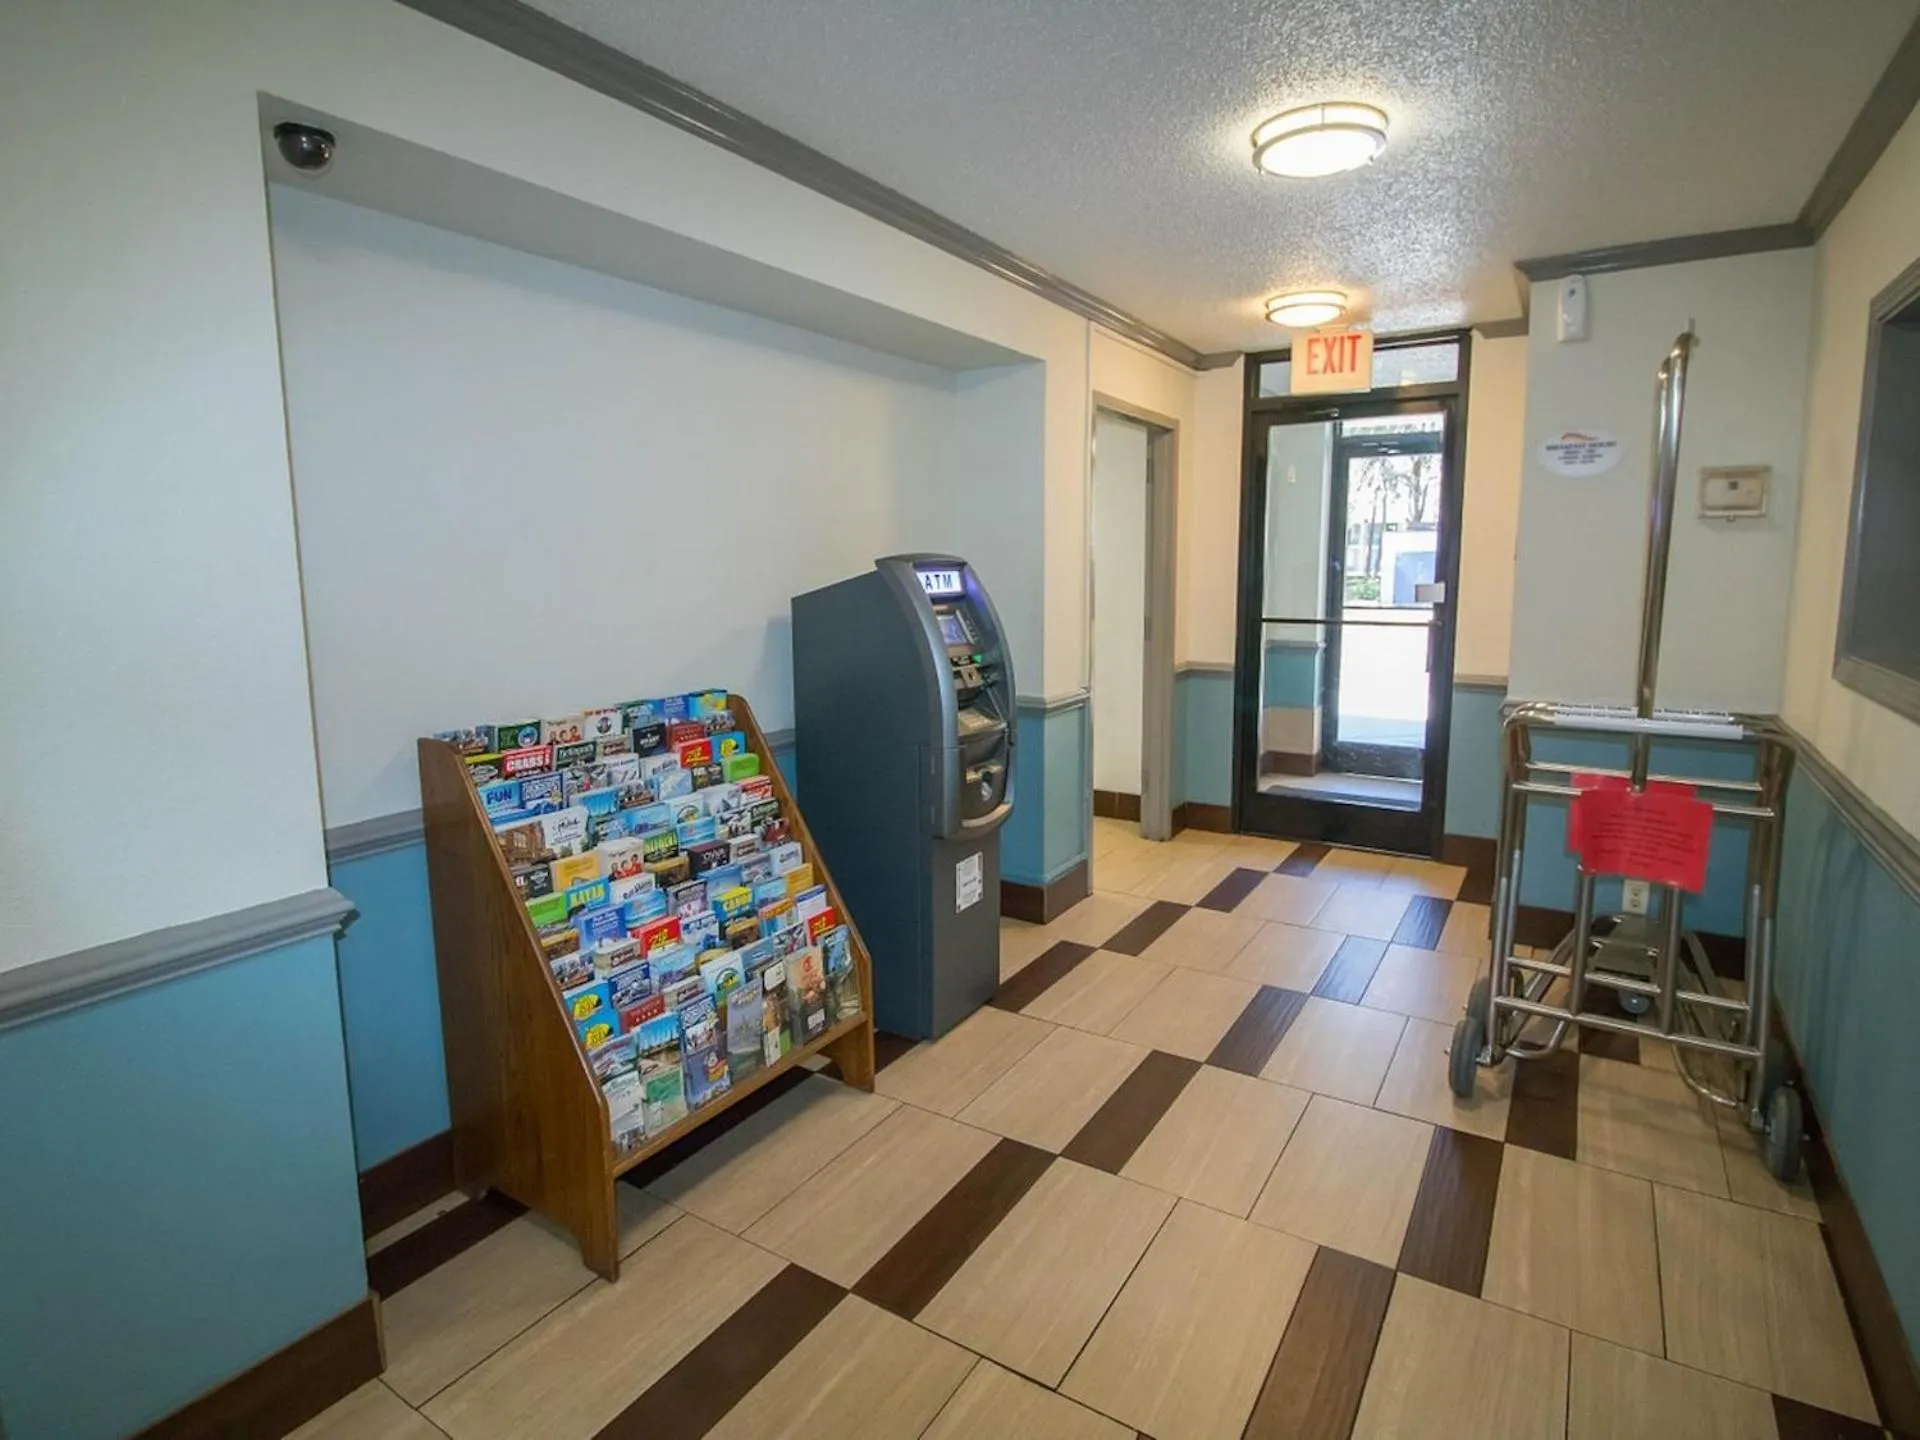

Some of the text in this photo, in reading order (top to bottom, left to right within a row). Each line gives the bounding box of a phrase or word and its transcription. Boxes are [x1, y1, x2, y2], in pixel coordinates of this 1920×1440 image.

[1306, 334, 1362, 375] EXIT
[924, 573, 953, 590] ATM
[486, 788, 512, 804] FUN
